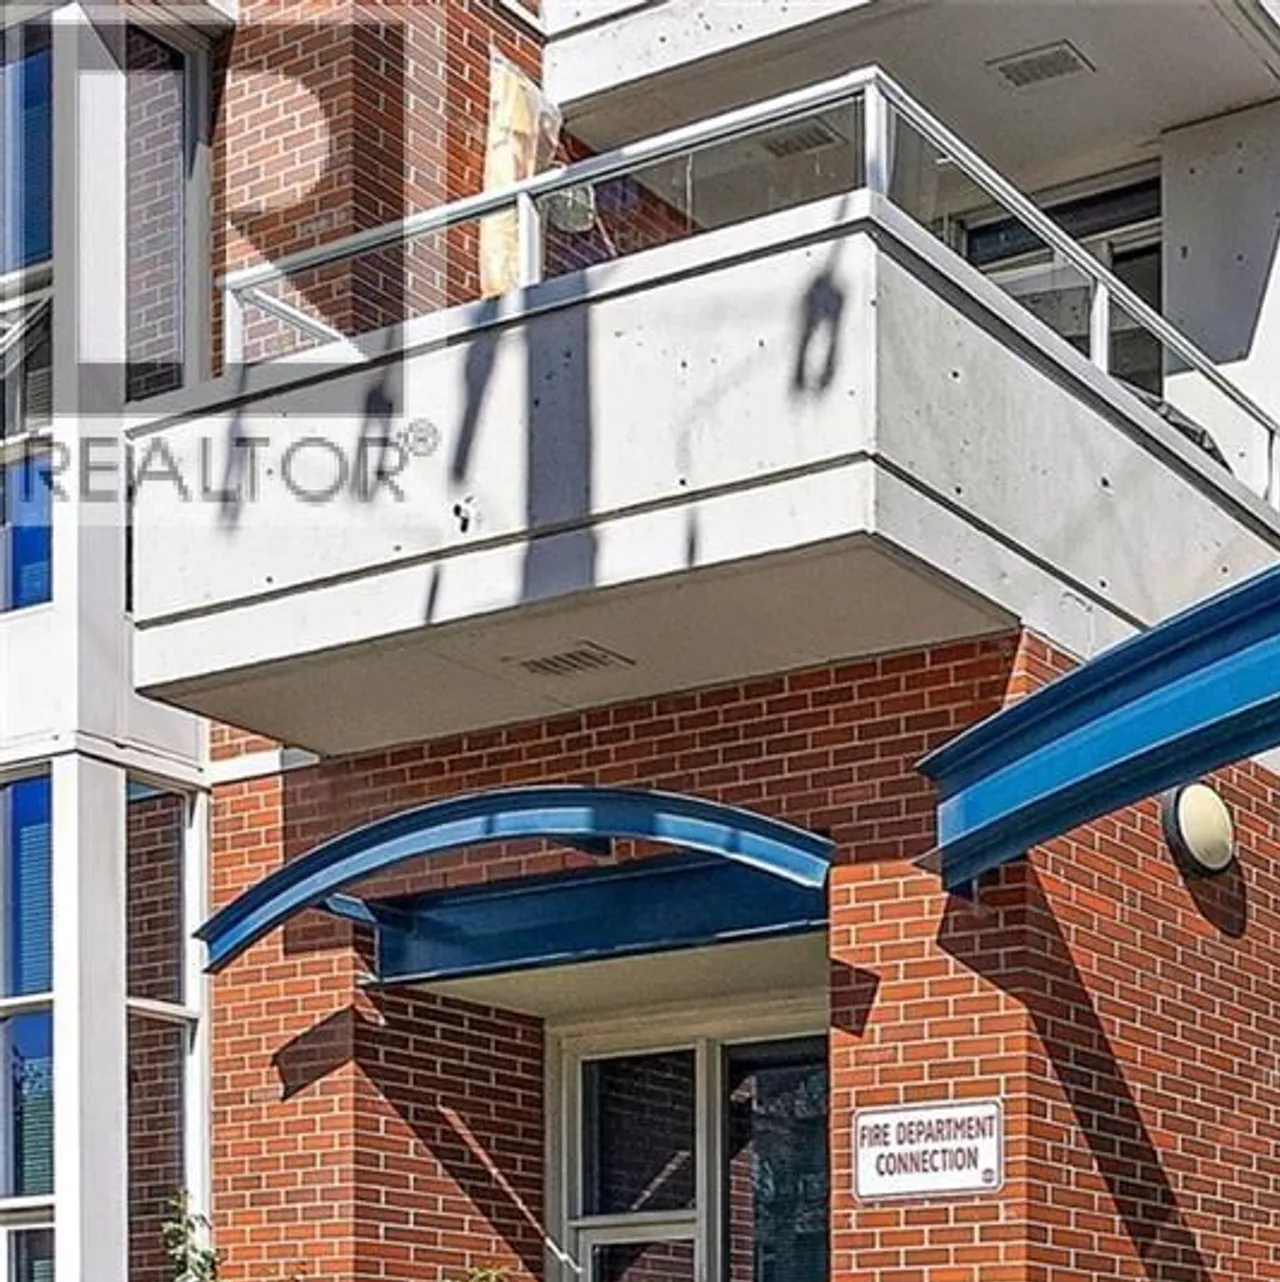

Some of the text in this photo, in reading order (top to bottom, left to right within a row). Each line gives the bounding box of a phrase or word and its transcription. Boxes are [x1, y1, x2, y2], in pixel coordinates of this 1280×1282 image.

[859, 1115, 996, 1149] FIRE DEPARTMENT
[875, 1147, 979, 1177] CONNECTION
